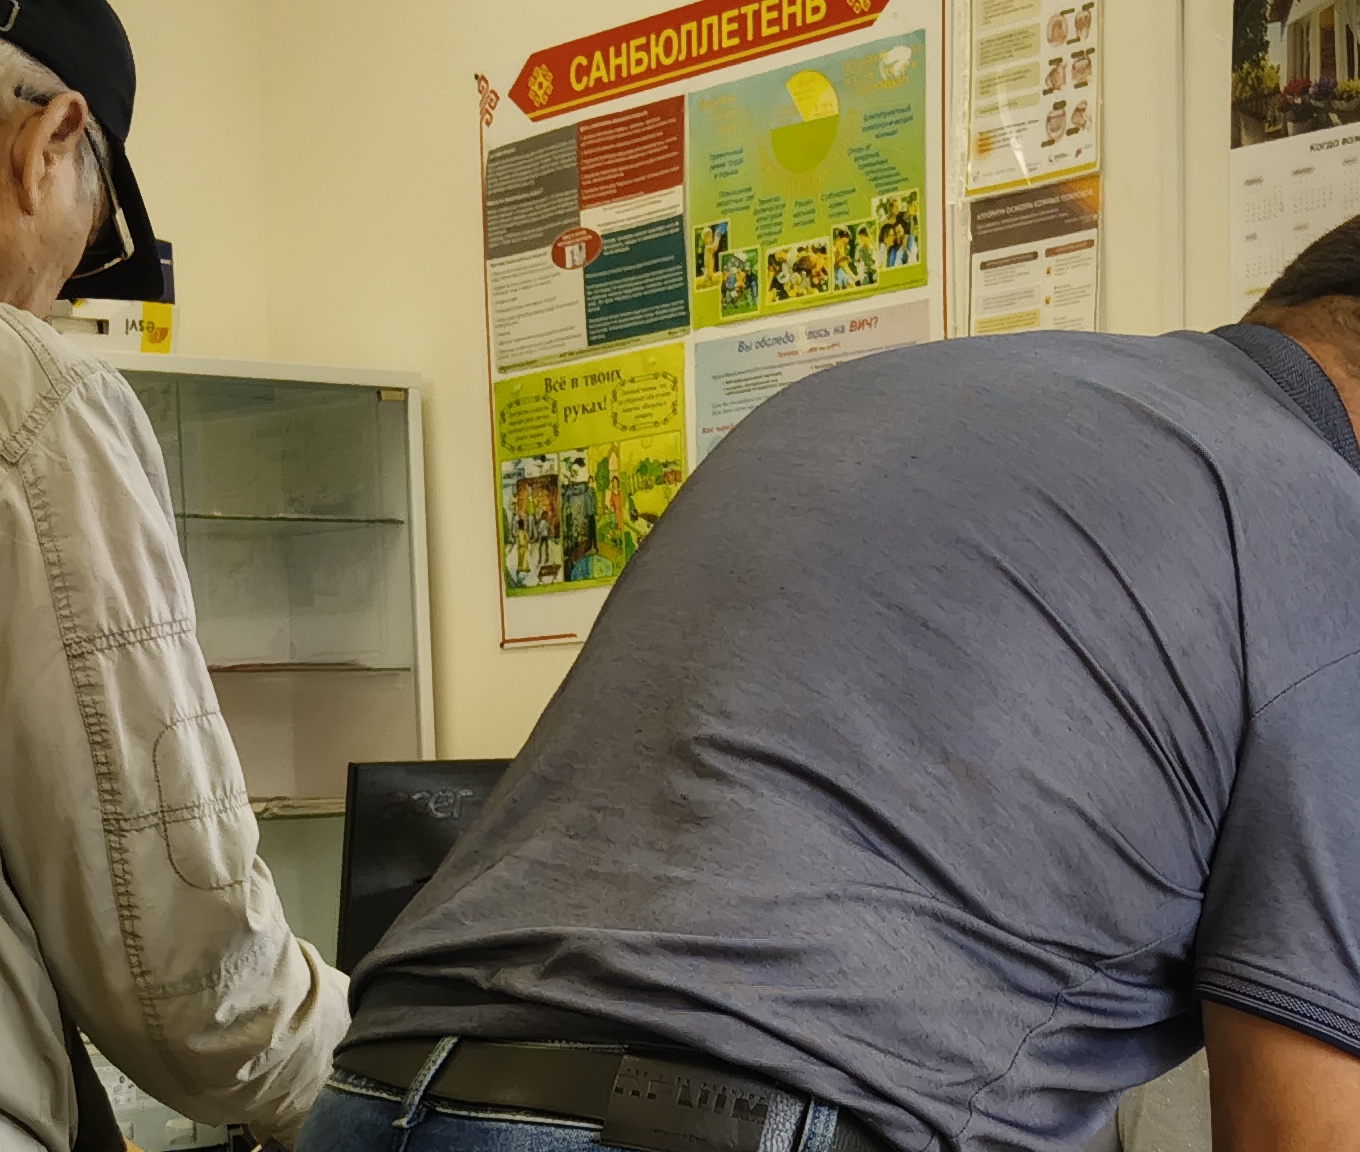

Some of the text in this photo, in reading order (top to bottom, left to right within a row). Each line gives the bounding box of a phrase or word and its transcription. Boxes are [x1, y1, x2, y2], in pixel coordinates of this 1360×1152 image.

[569, 0, 828, 92] САНБЮЛЛЕТЕНЬ
[848, 316, 879, 333] ВИЧ?
[544, 368, 623, 394] Всё в твоих
[563, 395, 607, 423] руках!
